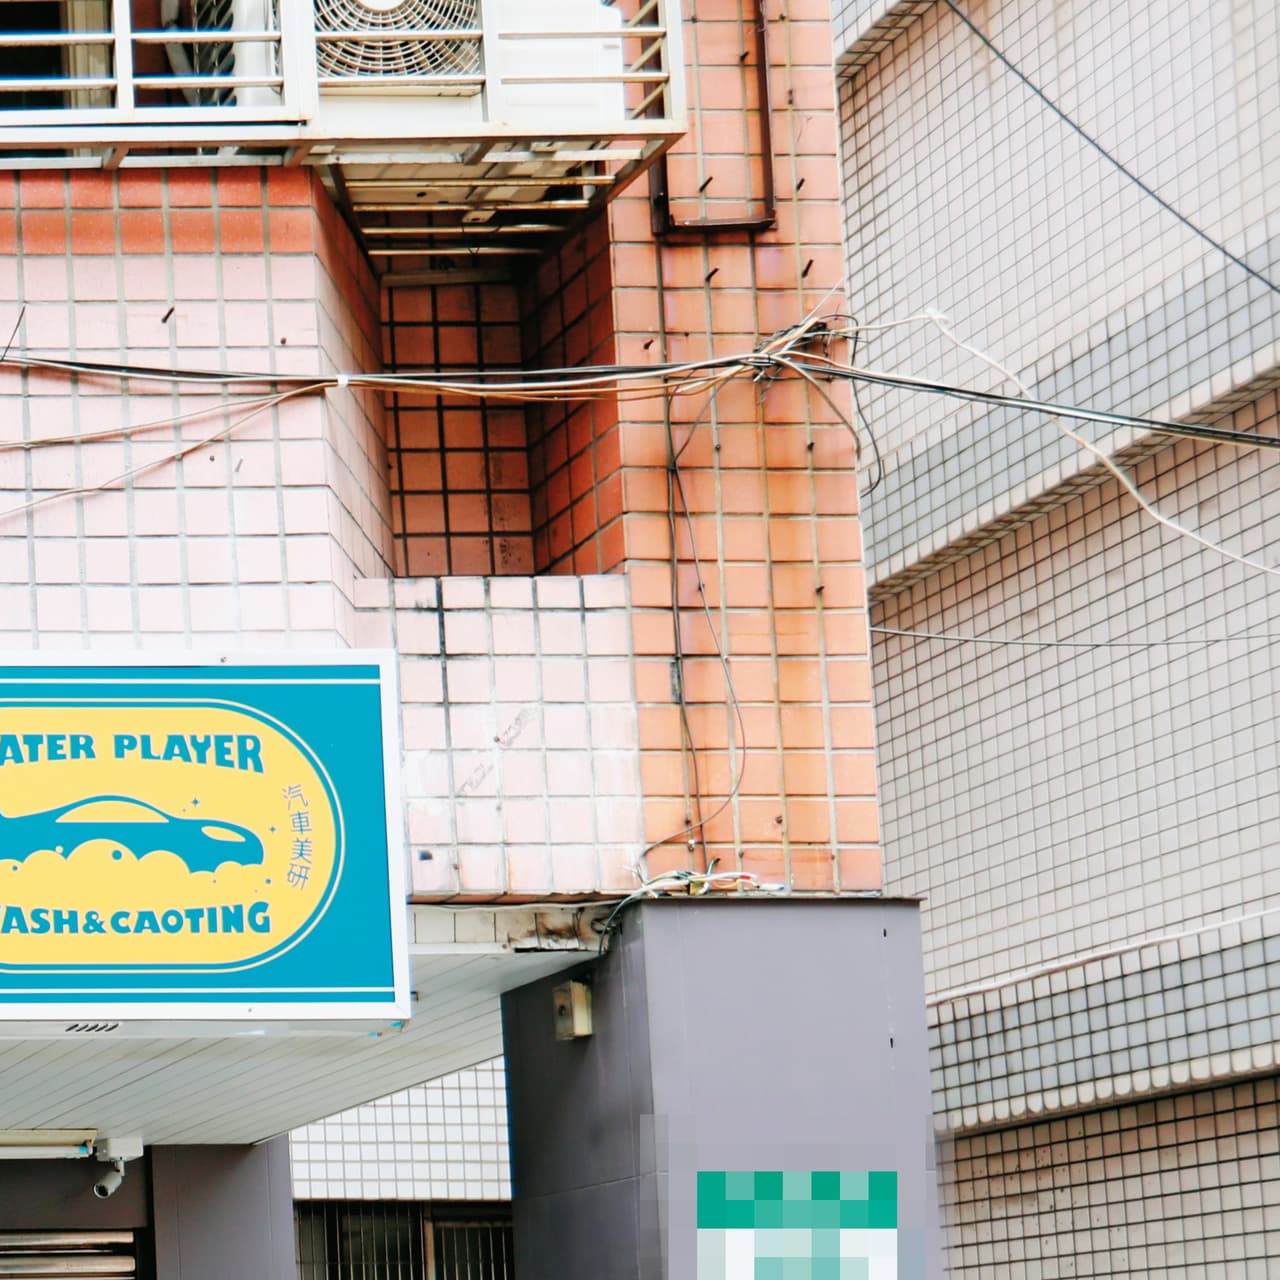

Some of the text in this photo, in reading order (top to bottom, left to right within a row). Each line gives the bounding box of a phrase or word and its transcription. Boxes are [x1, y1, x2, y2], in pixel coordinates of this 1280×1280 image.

[113, 733, 265, 774] PLAYER
[281, 783, 311, 891] 汽車美研
